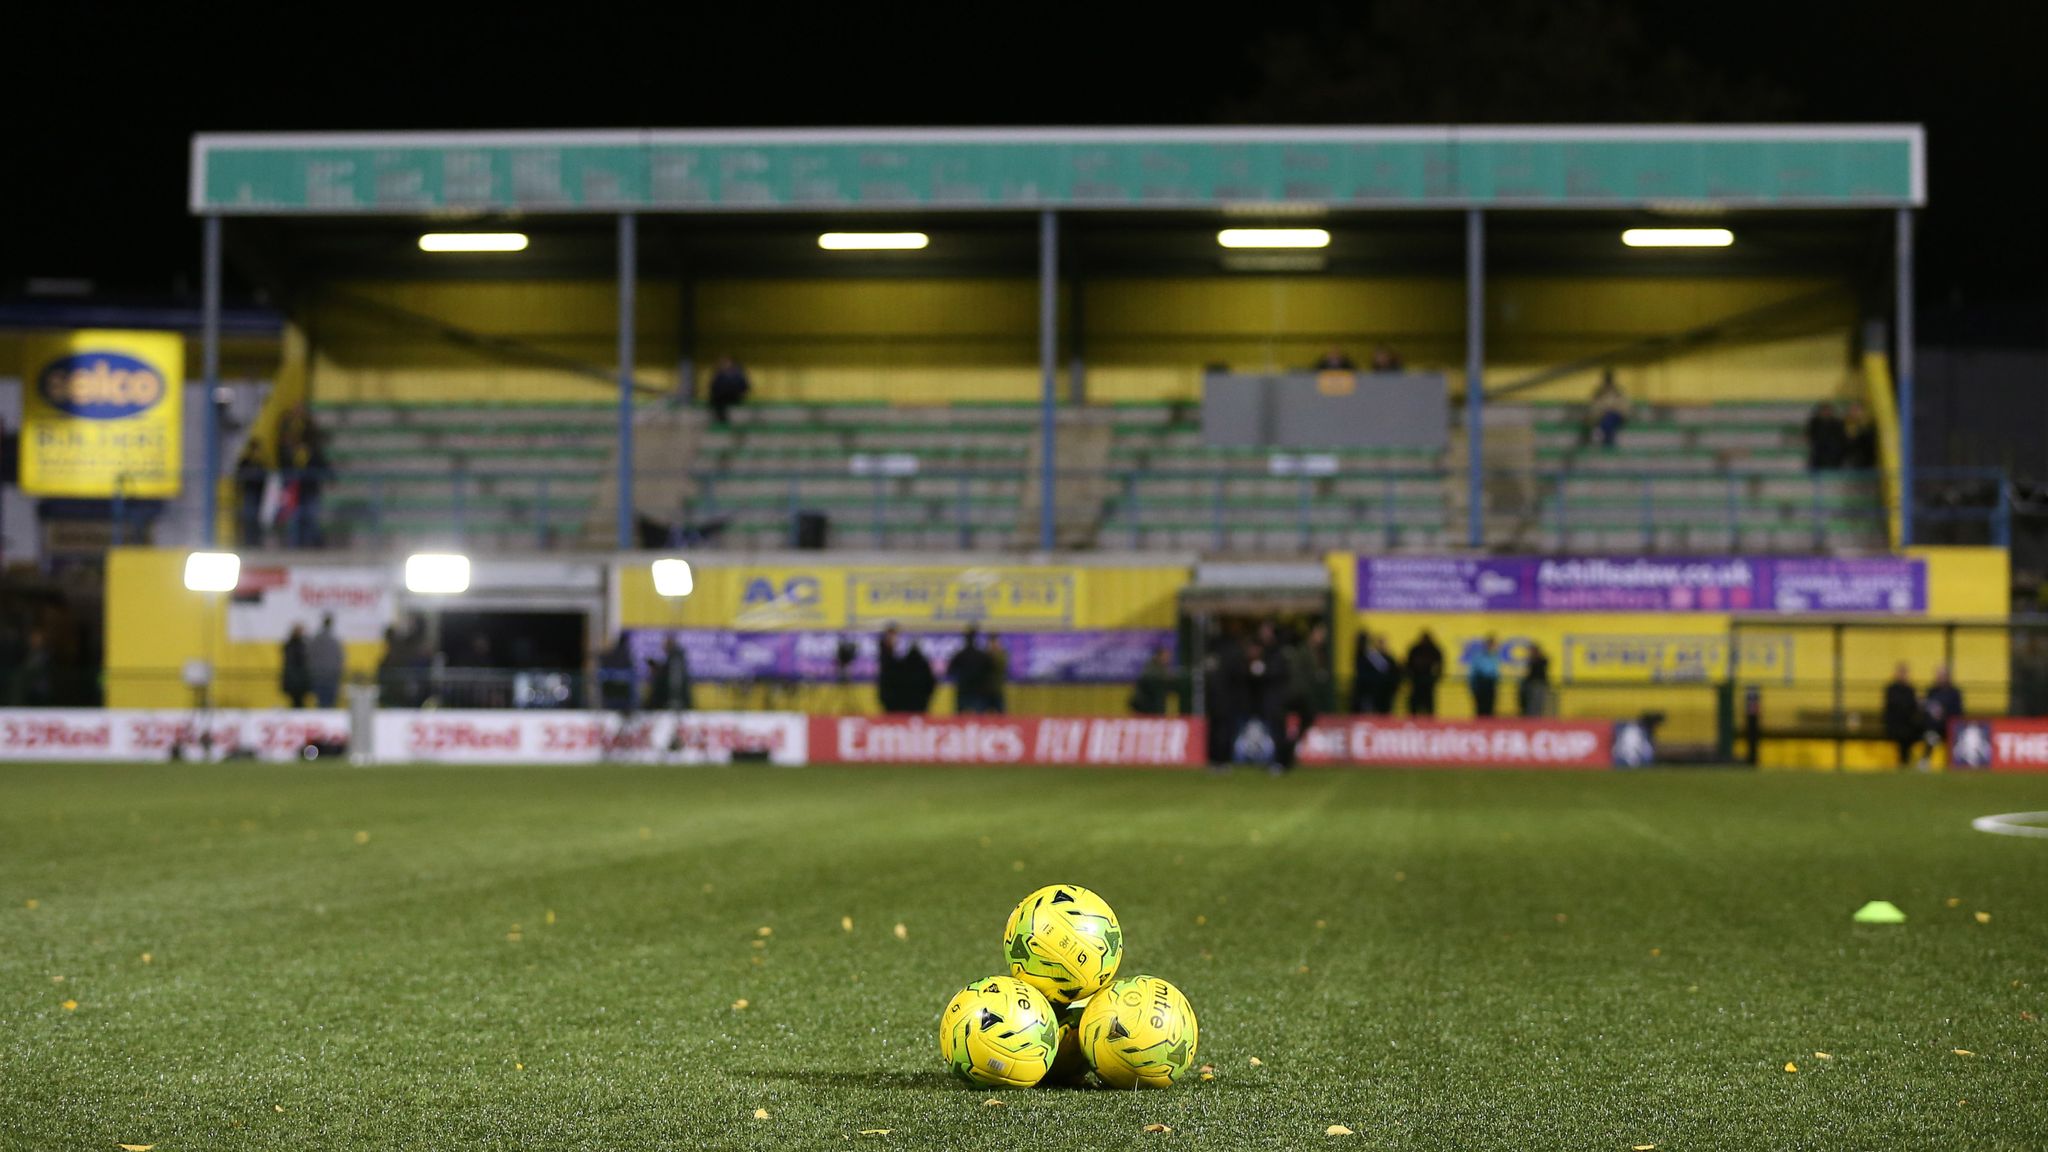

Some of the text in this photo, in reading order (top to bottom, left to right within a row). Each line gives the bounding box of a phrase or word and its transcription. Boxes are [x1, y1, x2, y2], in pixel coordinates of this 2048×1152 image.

[837, 717, 1024, 760] Emirates
[1086, 719, 1190, 762] BETTER
[1351, 722, 1488, 759] Emirates
[1492, 729, 1525, 760] FA
[1527, 728, 1597, 761] CUP
[1150, 981, 1171, 1029] mitre
